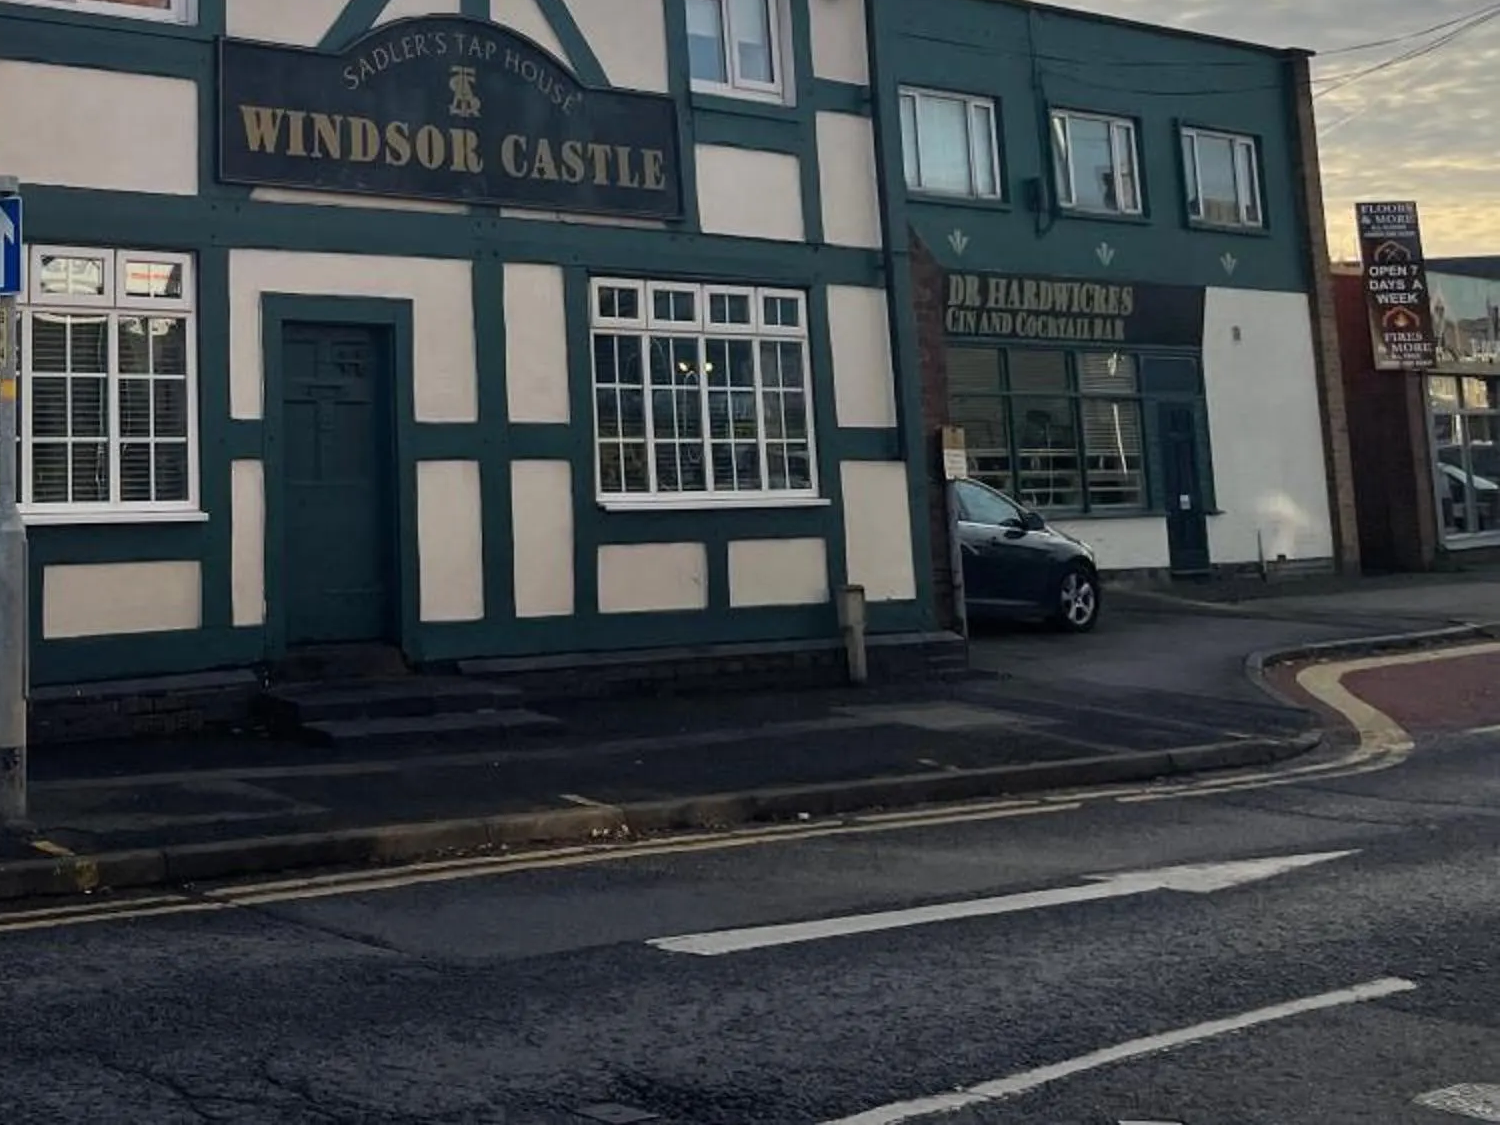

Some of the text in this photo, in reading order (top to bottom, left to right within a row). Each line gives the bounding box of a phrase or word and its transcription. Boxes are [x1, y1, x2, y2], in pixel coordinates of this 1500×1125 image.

[343, 31, 447, 90] SADLER'S
[455, 32, 497, 60] TAP
[505, 49, 583, 114] HOUSE
[239, 105, 667, 191] WINDSOR CASTLE
[1369, 265, 1418, 276] OPEN 7
[1369, 279, 1423, 290] DAYS A
[1376, 293, 1418, 304] WEEK
[946, 307, 976, 334] GIN
[978, 309, 1012, 335] AND
[1391, 342, 1432, 353] MORE
